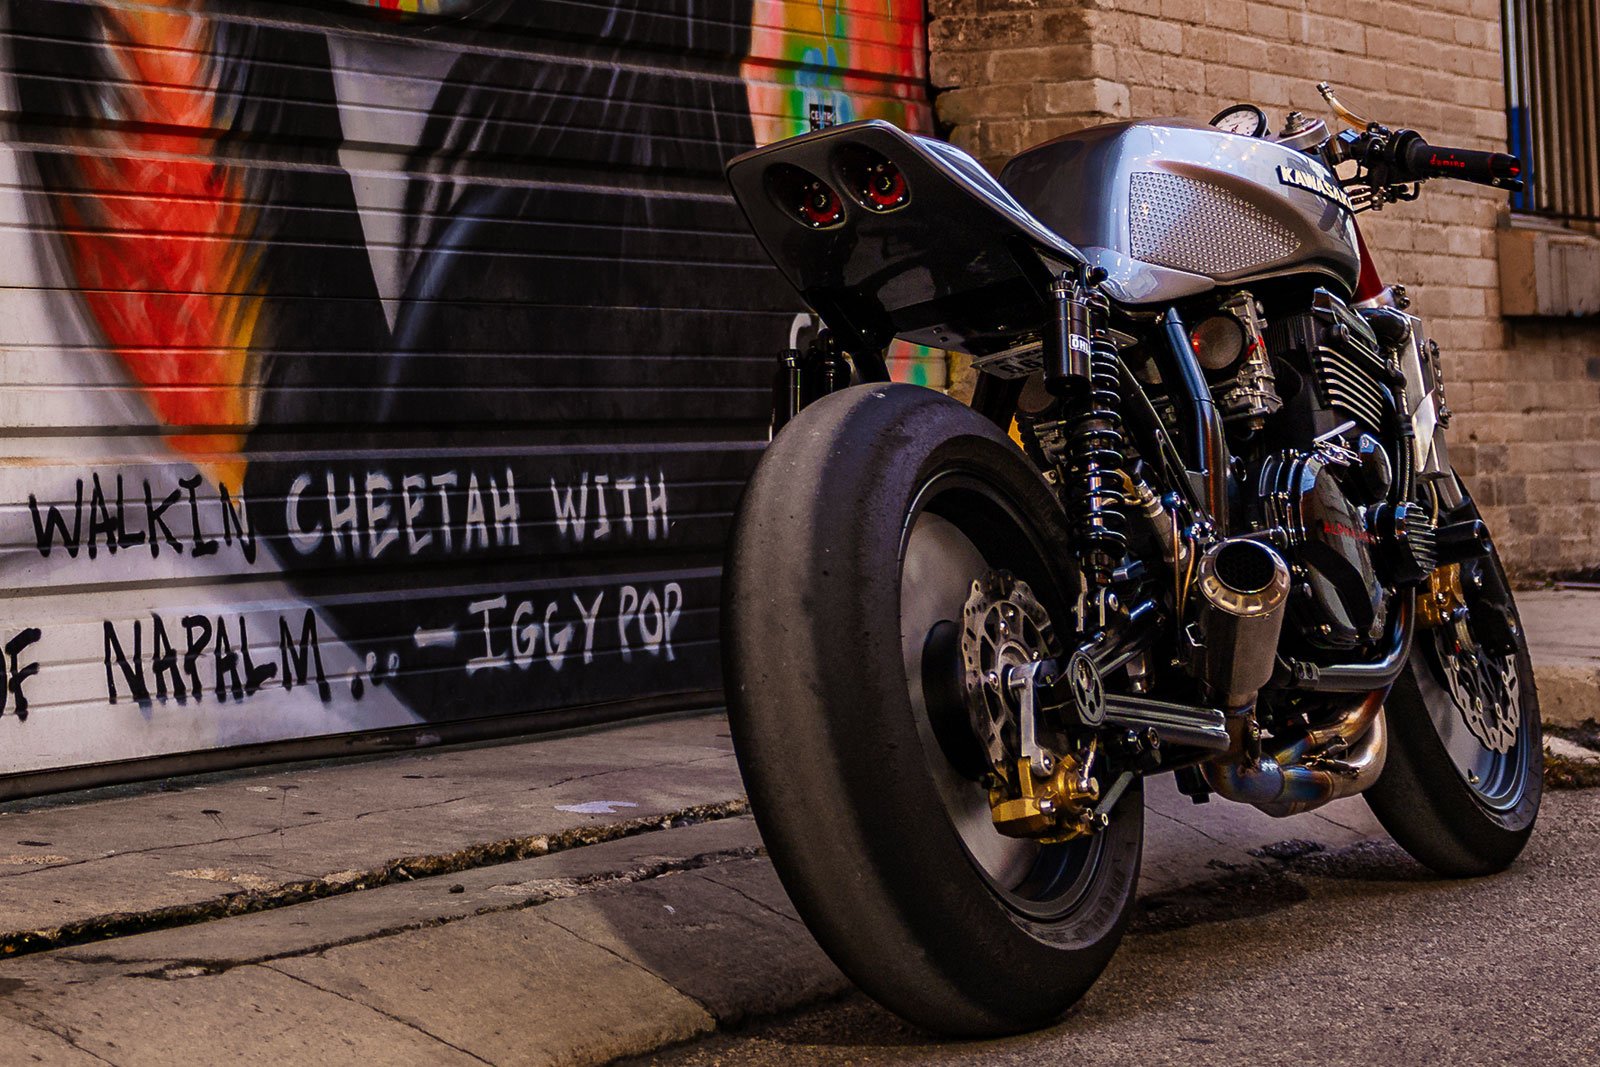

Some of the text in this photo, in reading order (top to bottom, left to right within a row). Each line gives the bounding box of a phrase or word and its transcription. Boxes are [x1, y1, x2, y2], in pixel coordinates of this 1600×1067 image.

[28, 467, 669, 564] WALKIN CHEETAH WITH
[465, 591, 604, 673] IGGY
[618, 582, 683, 663] POP
